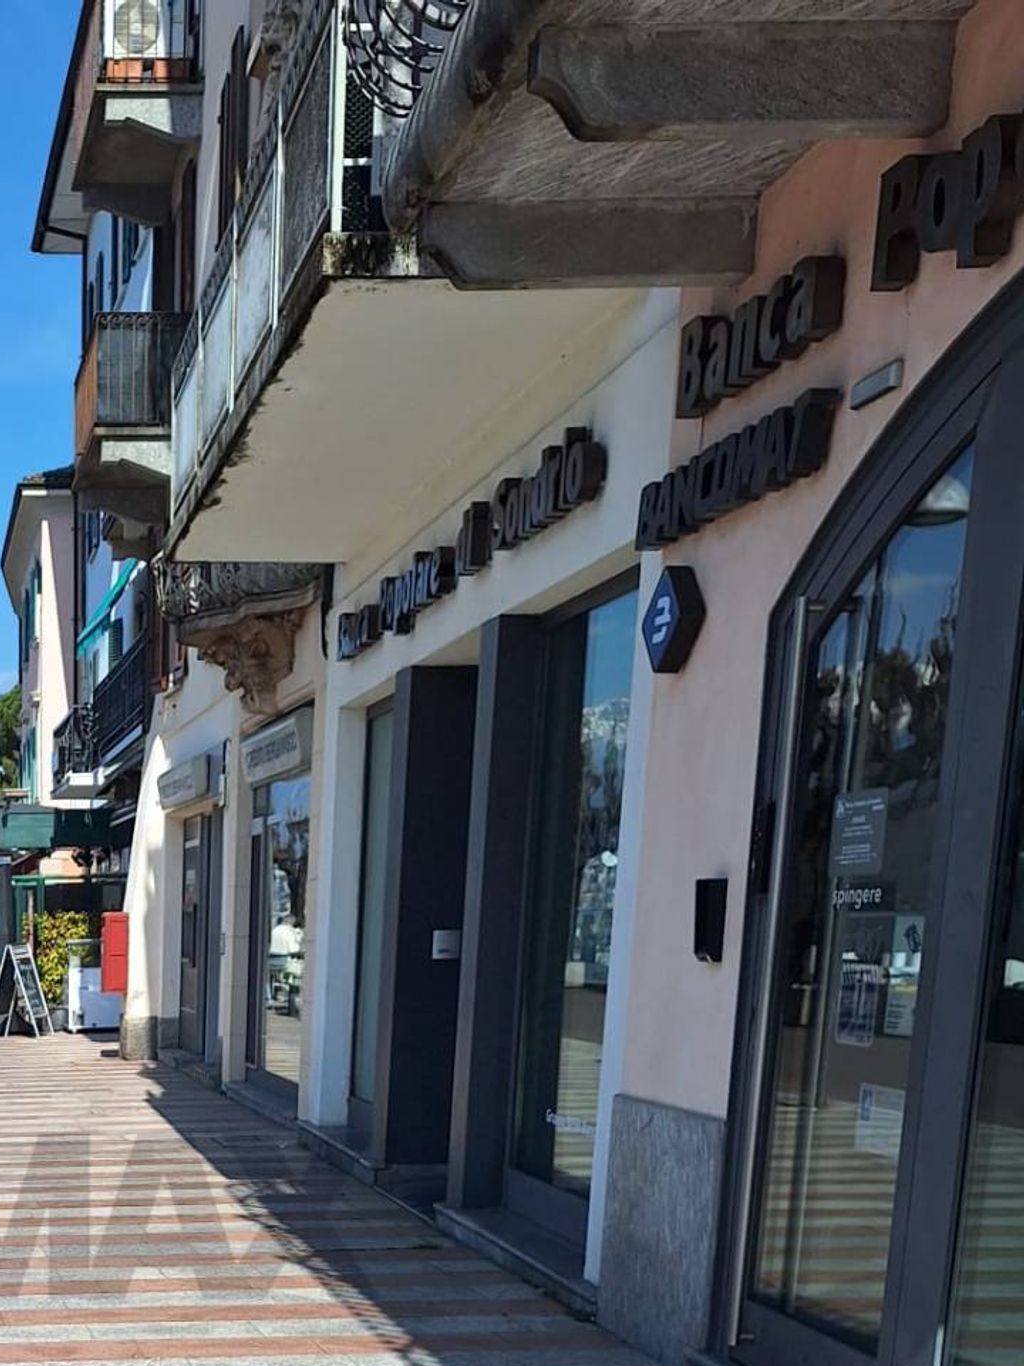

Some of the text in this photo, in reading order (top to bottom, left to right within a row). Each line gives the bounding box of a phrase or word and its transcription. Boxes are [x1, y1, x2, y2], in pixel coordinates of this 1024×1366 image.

[676, 113, 1024, 418] Banca Pop
[379, 547, 456, 635] Popolare
[490, 427, 607, 549] Sondrio
[636, 388, 843, 550] BANCOMAT
[832, 887, 882, 910] spingere
